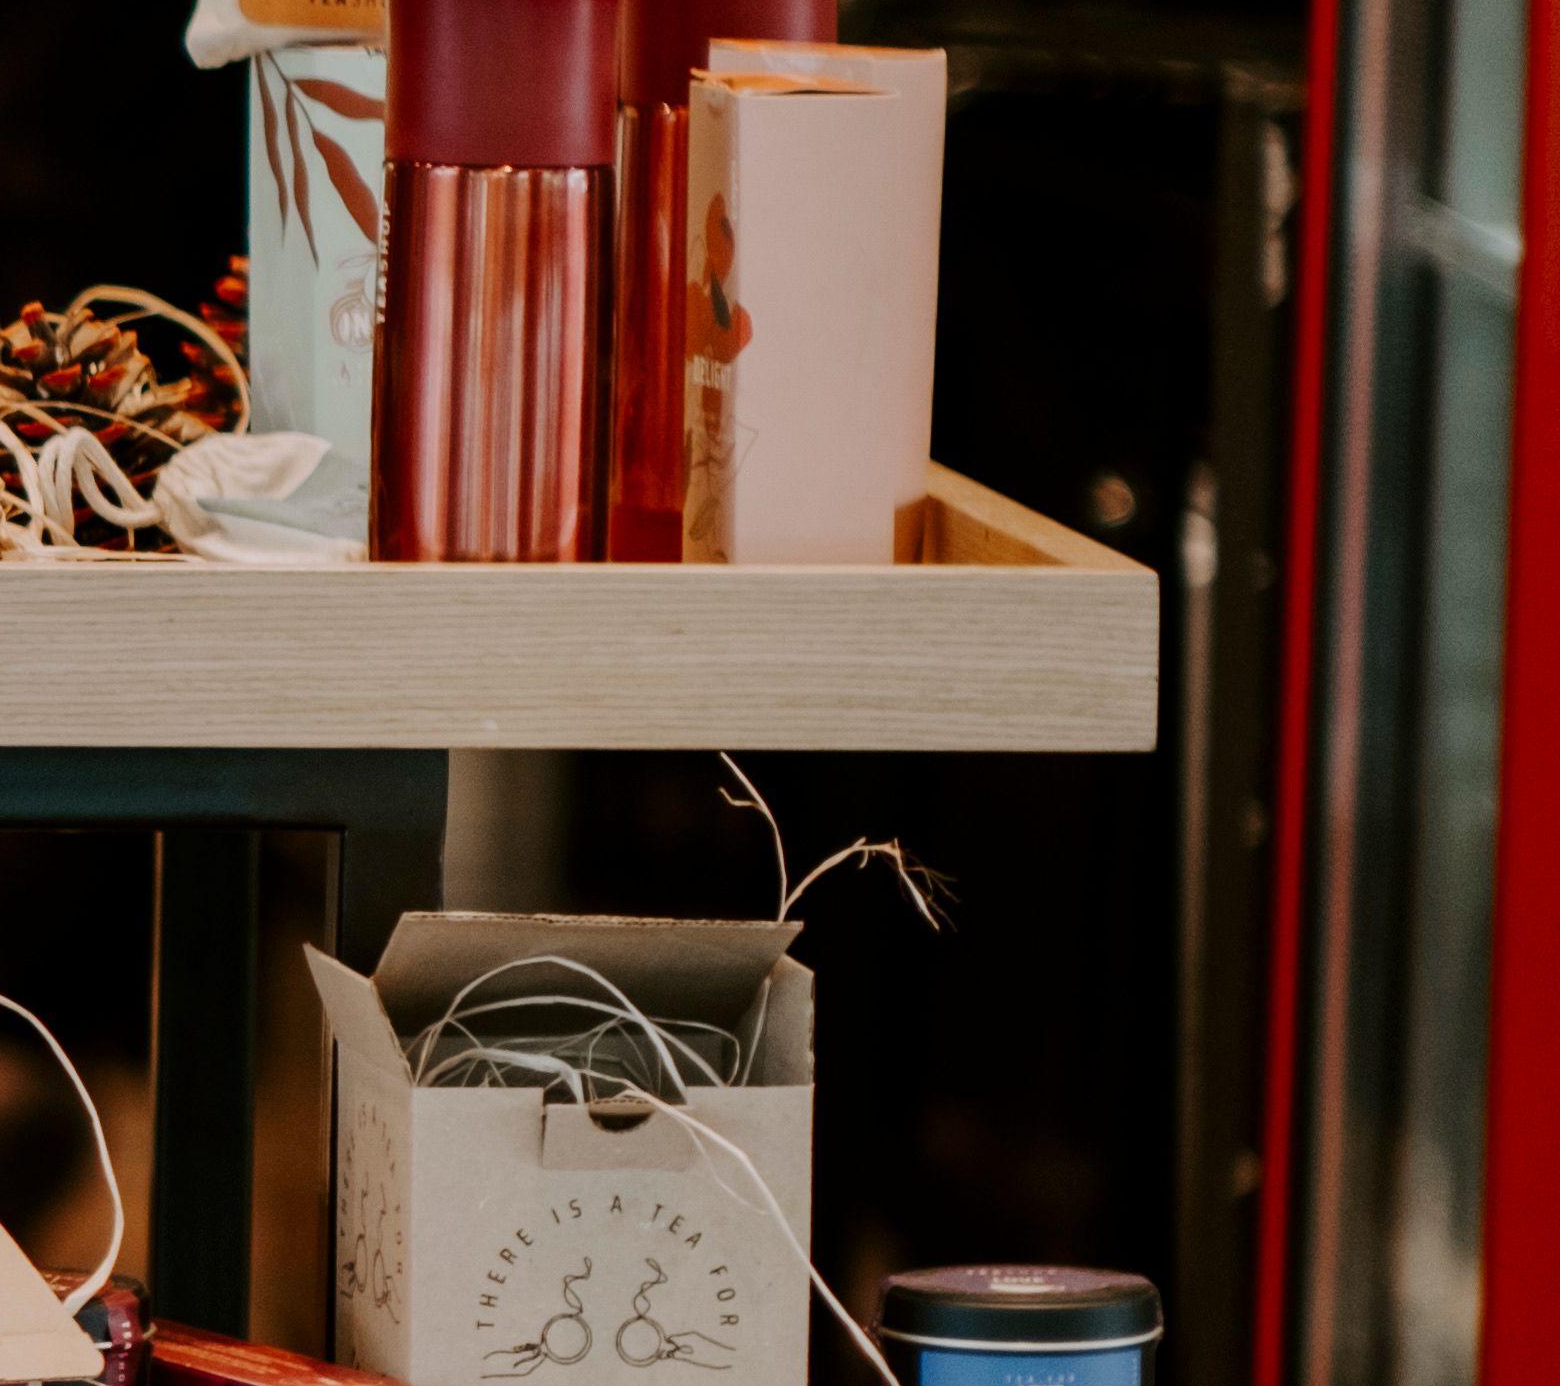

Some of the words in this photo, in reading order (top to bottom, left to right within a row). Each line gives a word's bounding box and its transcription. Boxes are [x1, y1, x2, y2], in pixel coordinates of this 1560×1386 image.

[476, 1227, 534, 1331] THERE
[550, 1198, 583, 1225] IS
[609, 1194, 623, 1214] A
[648, 1203, 703, 1250] TEA
[709, 1263, 740, 1328] FOR
